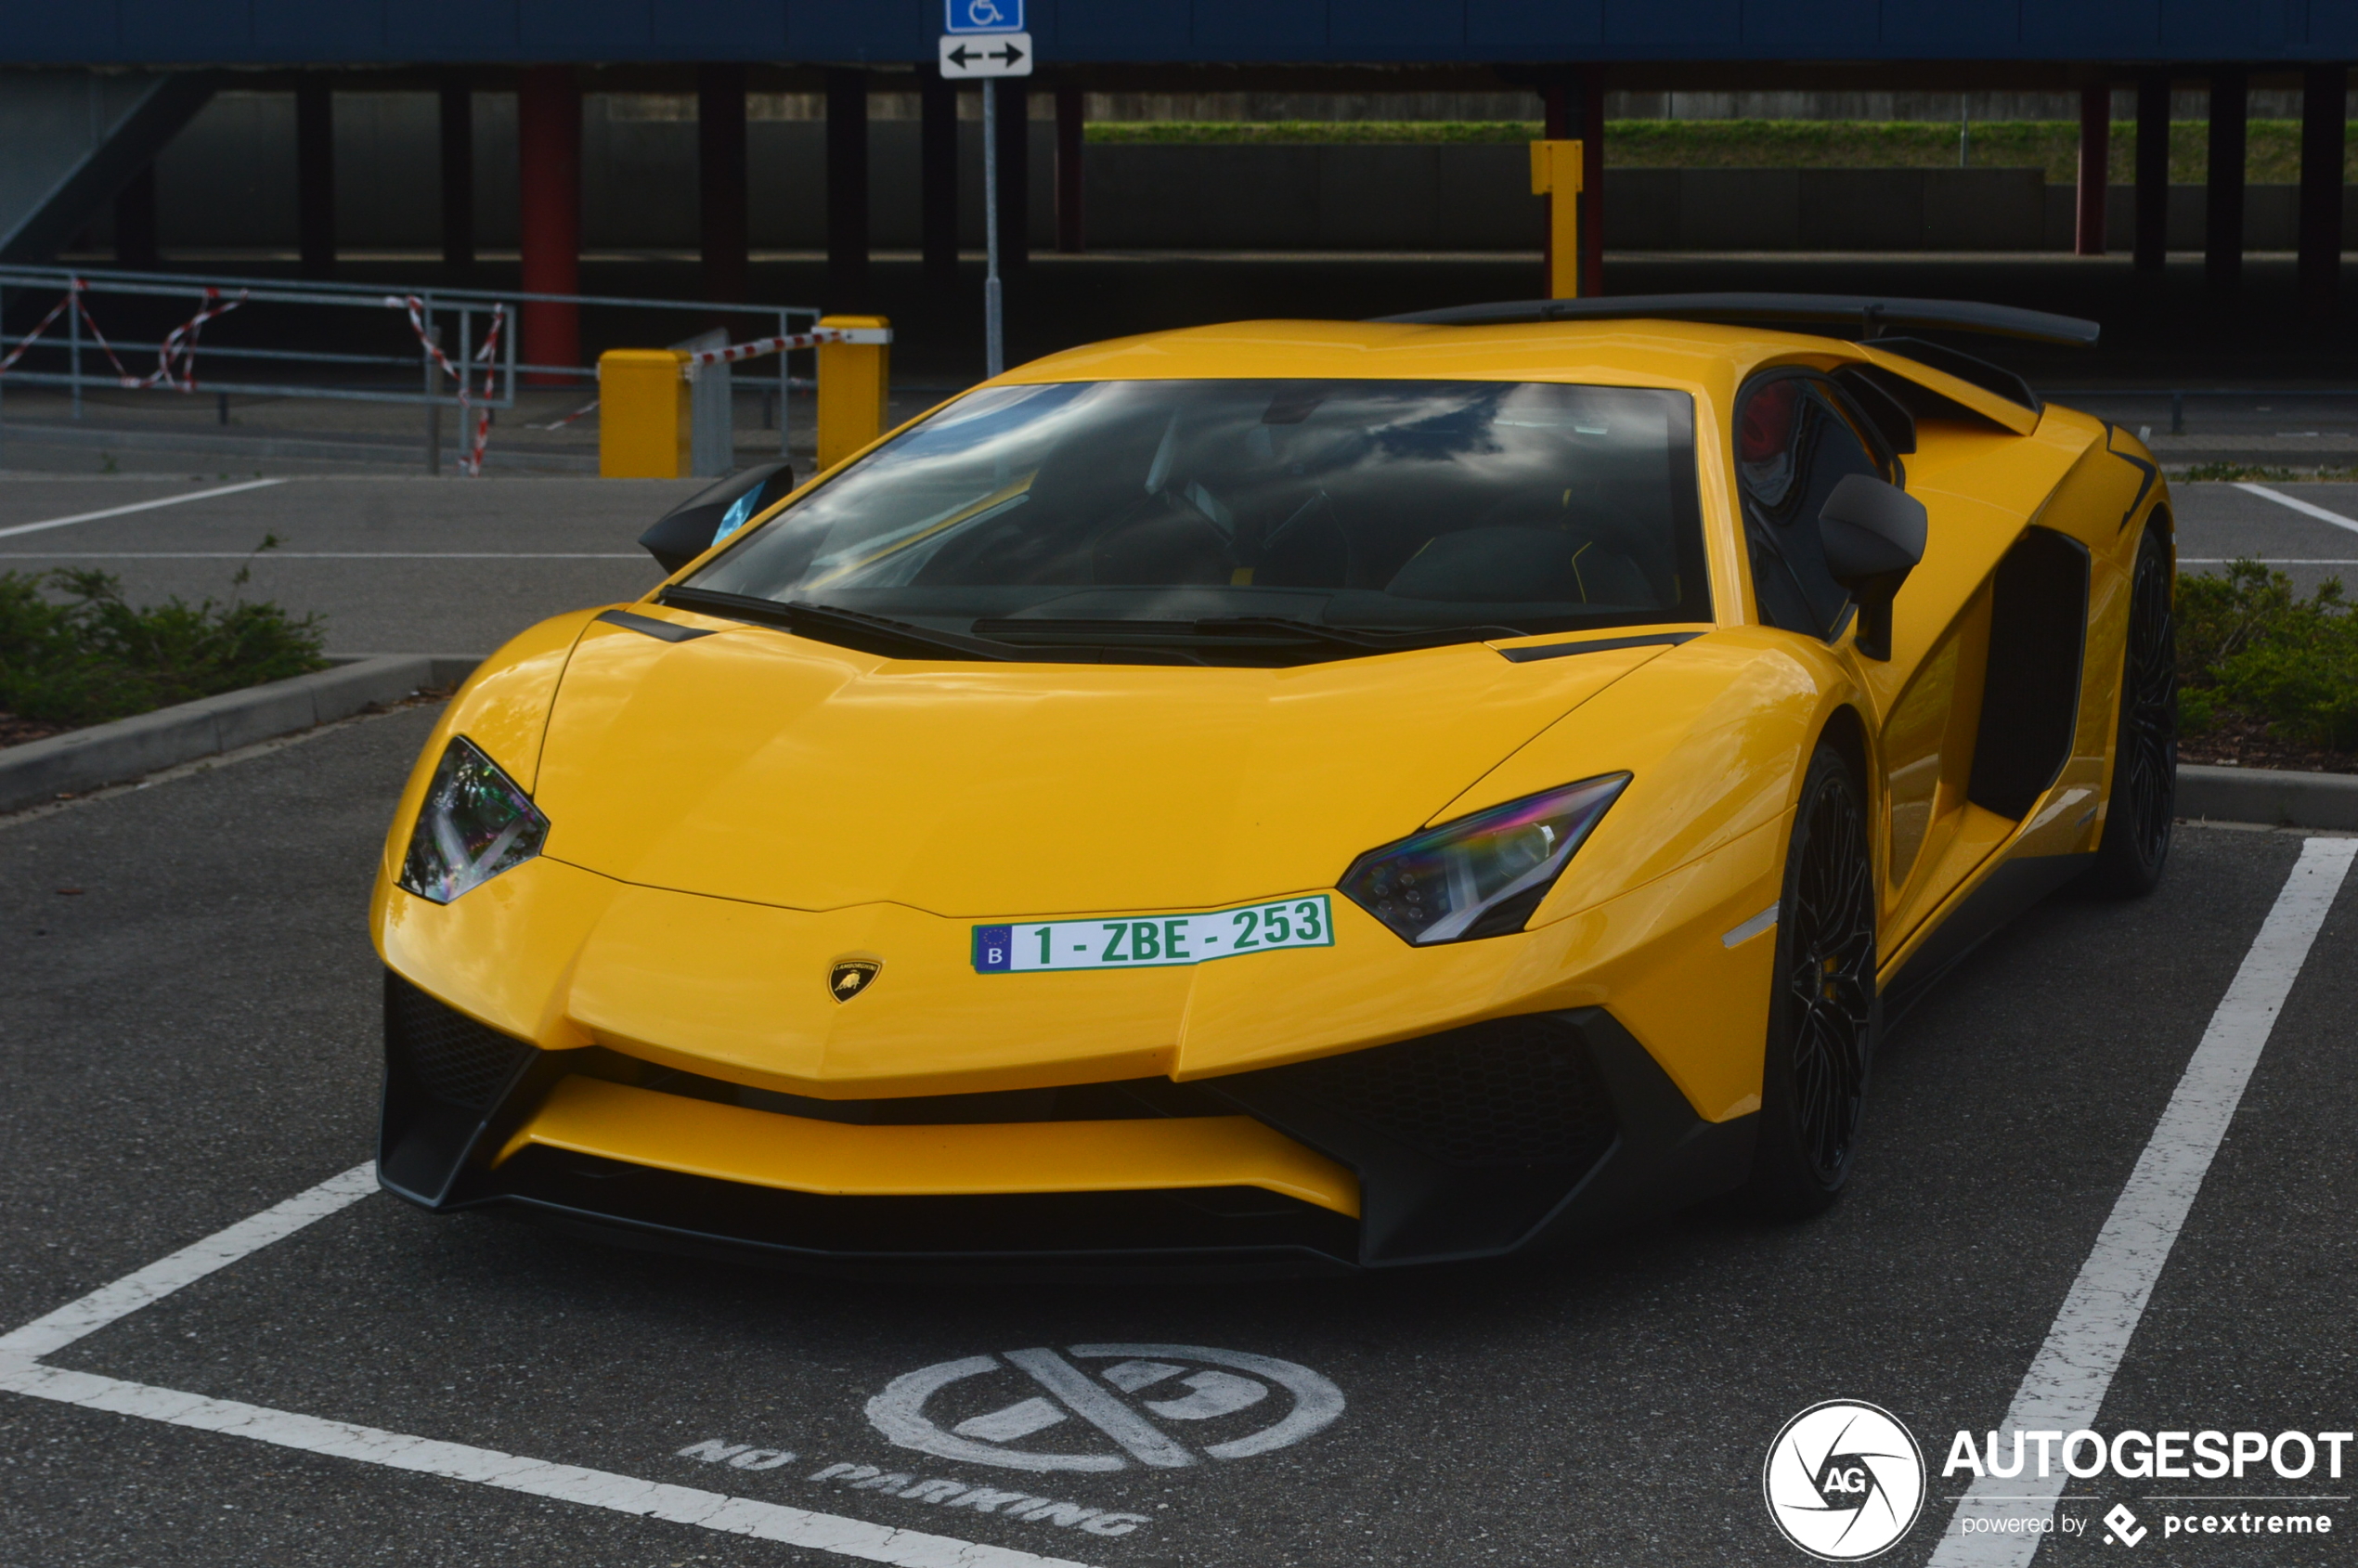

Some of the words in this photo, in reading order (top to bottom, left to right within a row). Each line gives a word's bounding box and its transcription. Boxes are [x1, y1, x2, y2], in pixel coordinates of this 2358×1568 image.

[1034, 927, 1052, 965] 1
[1101, 919, 1190, 962] ZBE
[1232, 901, 1322, 950] 253
[836, 963, 877, 972] LAMBORGHINI
[988, 948, 1004, 965] B
[674, 1438, 798, 1471] NO
[807, 1461, 1152, 1536] PARKING
